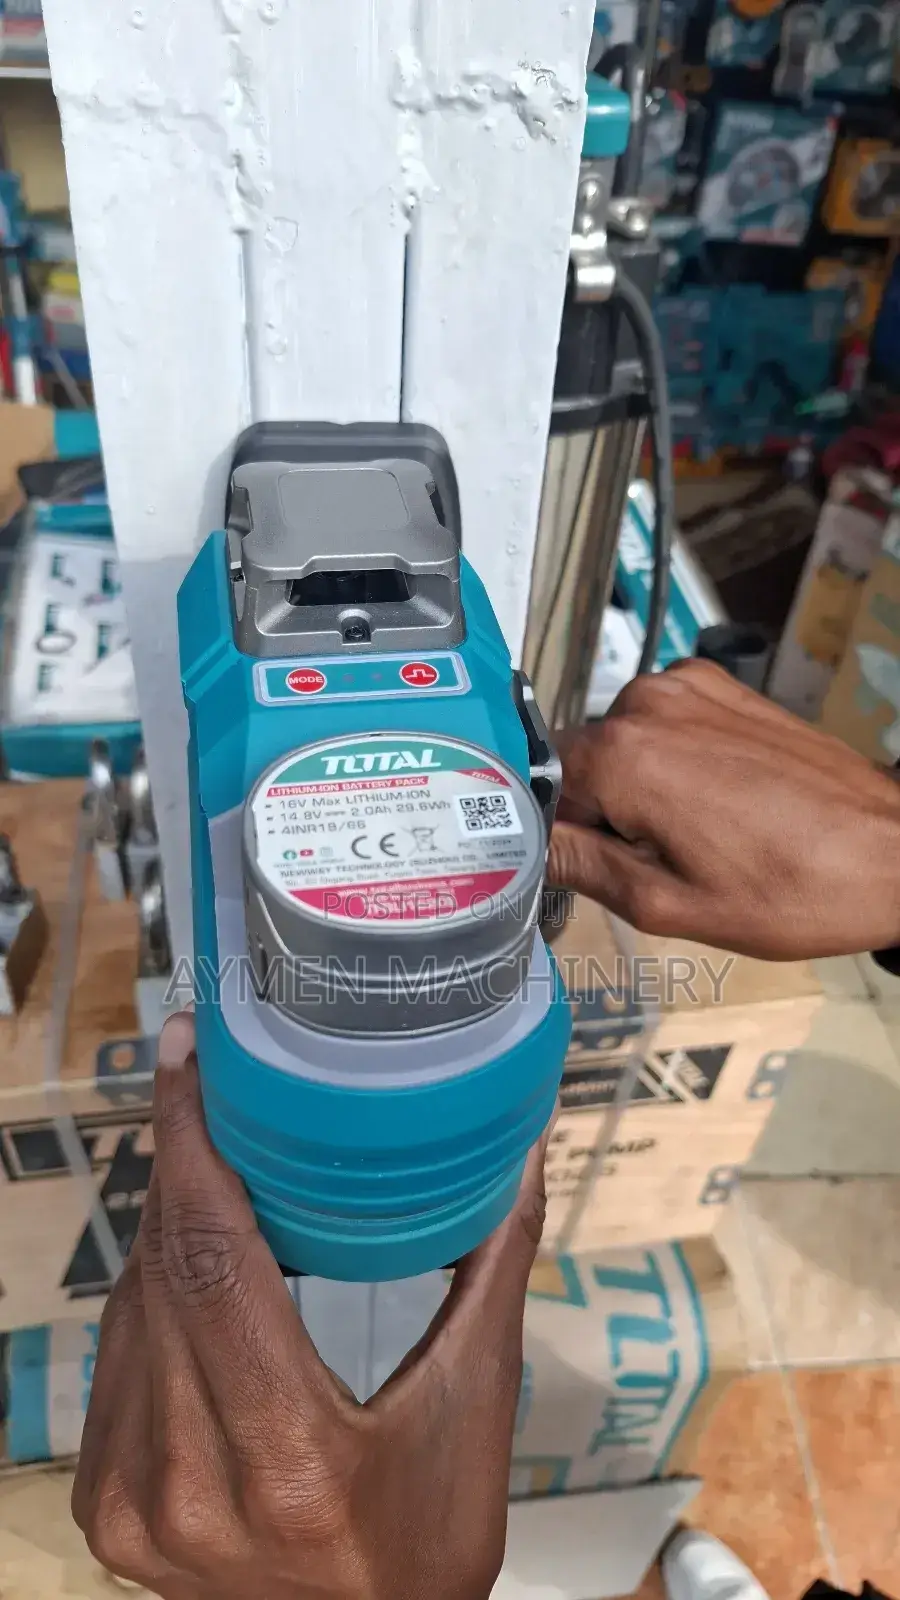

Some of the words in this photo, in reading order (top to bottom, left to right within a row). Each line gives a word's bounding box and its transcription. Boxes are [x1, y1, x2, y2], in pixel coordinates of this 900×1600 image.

[288, 676, 324, 685] MODE
[321, 749, 441, 776] TOTAL
[271, 783, 339, 796] LITHIUM-ION
[342, 780, 391, 791] BATTERY
[395, 777, 425, 787] PACK
[280, 798, 306, 809] 16V
[312, 797, 341, 807] Max
[345, 789, 431, 805] LITHIUM-ION
[396, 801, 451, 813] 29.6Wh
